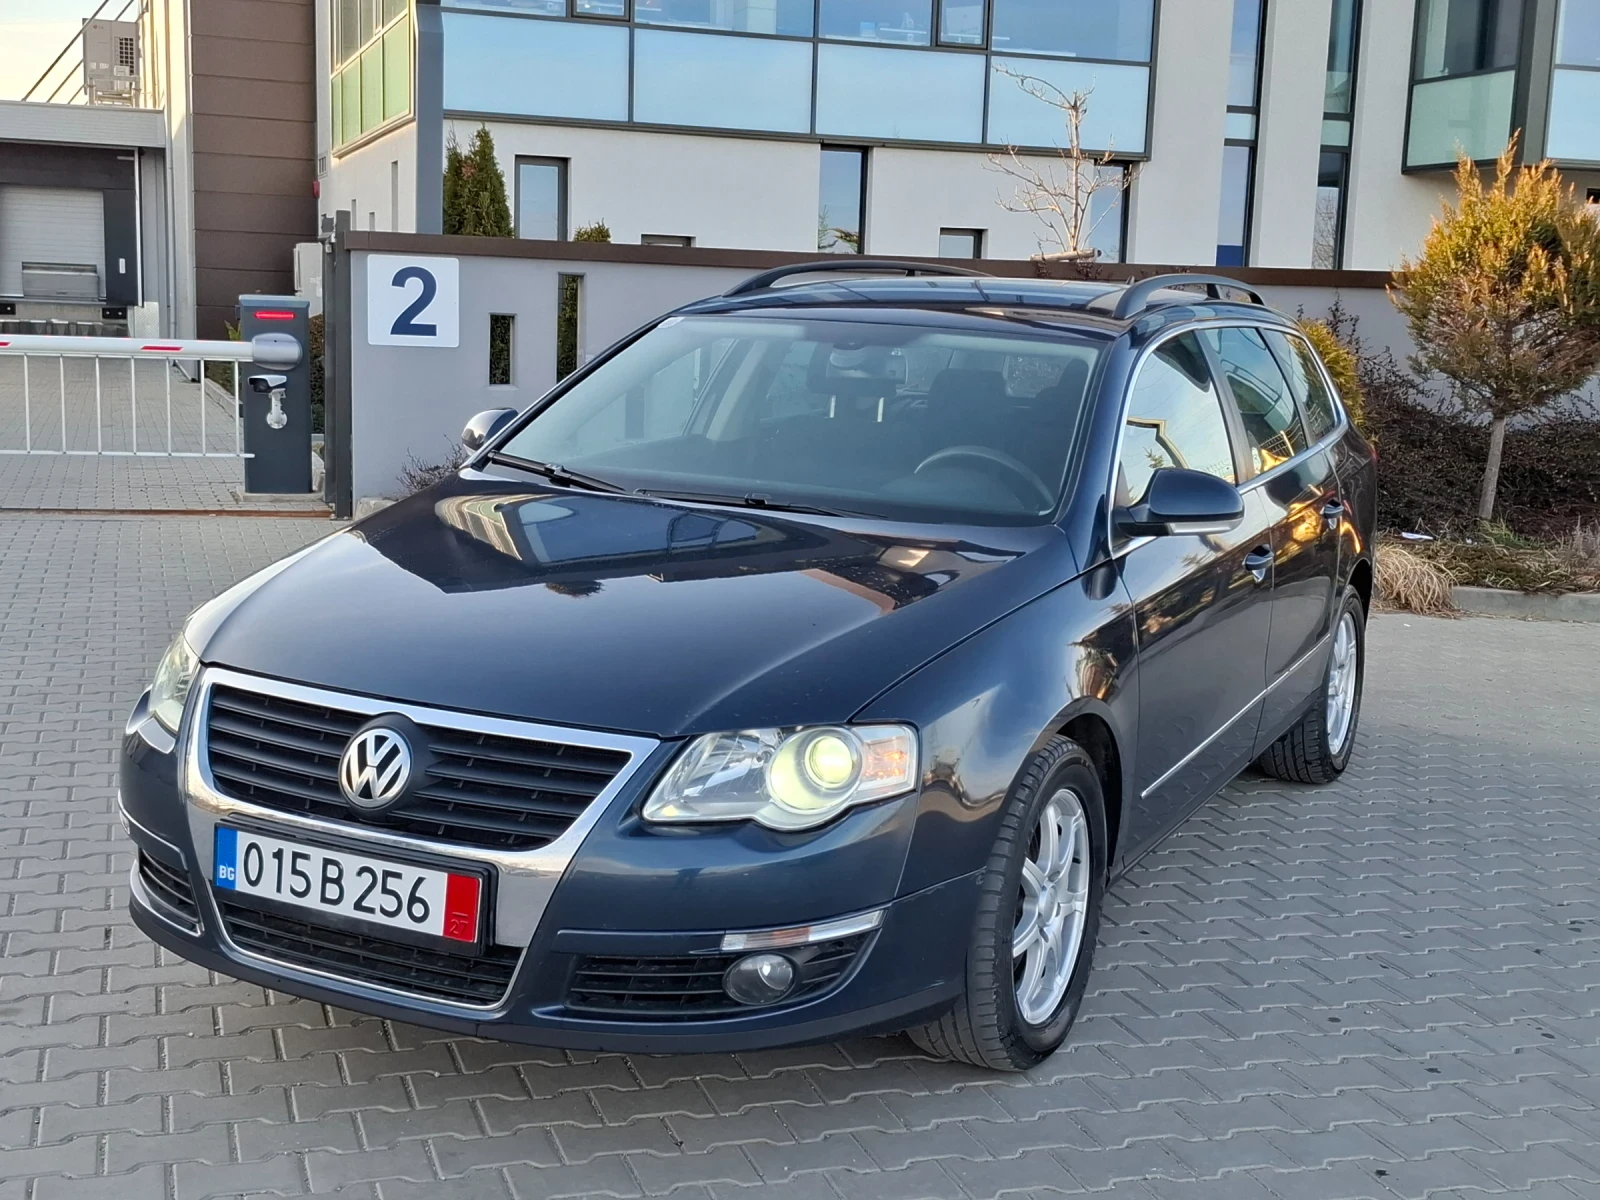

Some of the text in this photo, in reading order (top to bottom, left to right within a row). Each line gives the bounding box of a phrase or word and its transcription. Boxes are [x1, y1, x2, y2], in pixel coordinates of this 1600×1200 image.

[390, 266, 437, 336] 2
[341, 728, 411, 808] VW
[219, 864, 235, 882] BG
[243, 841, 431, 924] 015B256
